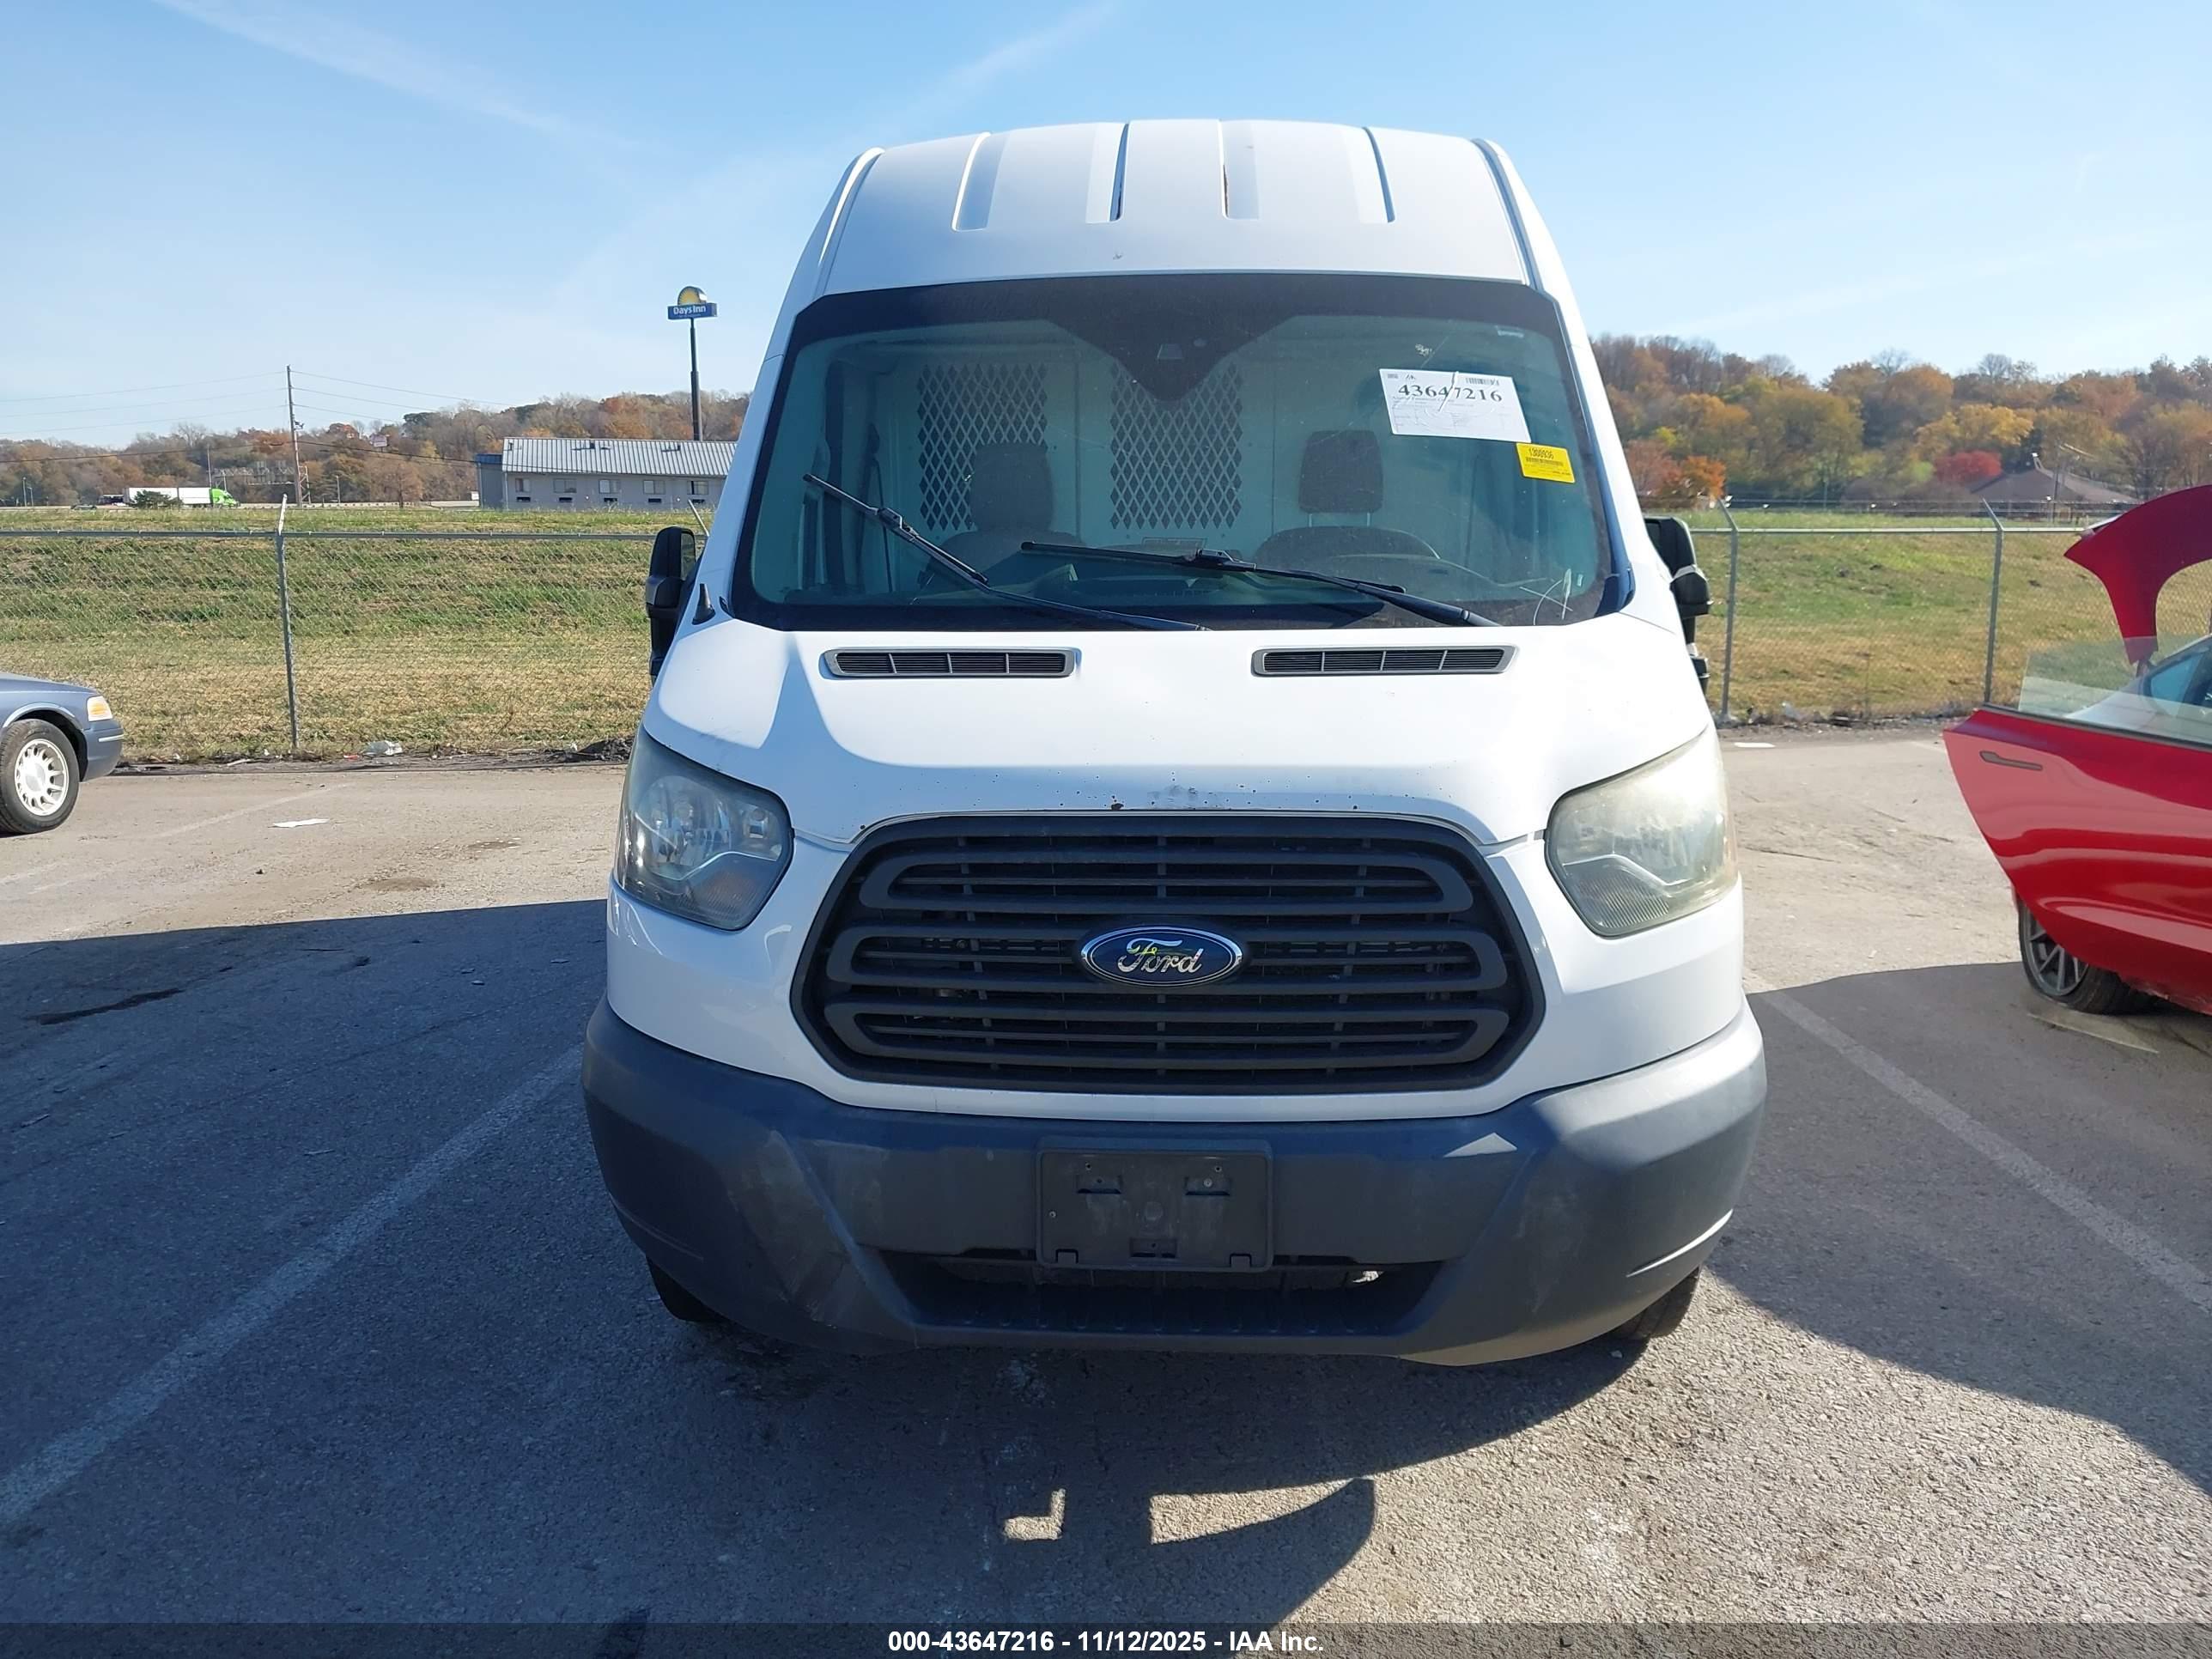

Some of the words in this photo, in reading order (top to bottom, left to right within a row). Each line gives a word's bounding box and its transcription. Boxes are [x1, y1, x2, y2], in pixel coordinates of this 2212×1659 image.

[673, 307, 692, 315] Days
[693, 305, 707, 313] Inn
[1398, 384, 1503, 403] 43647216
[1117, 938, 1204, 973] Ford
